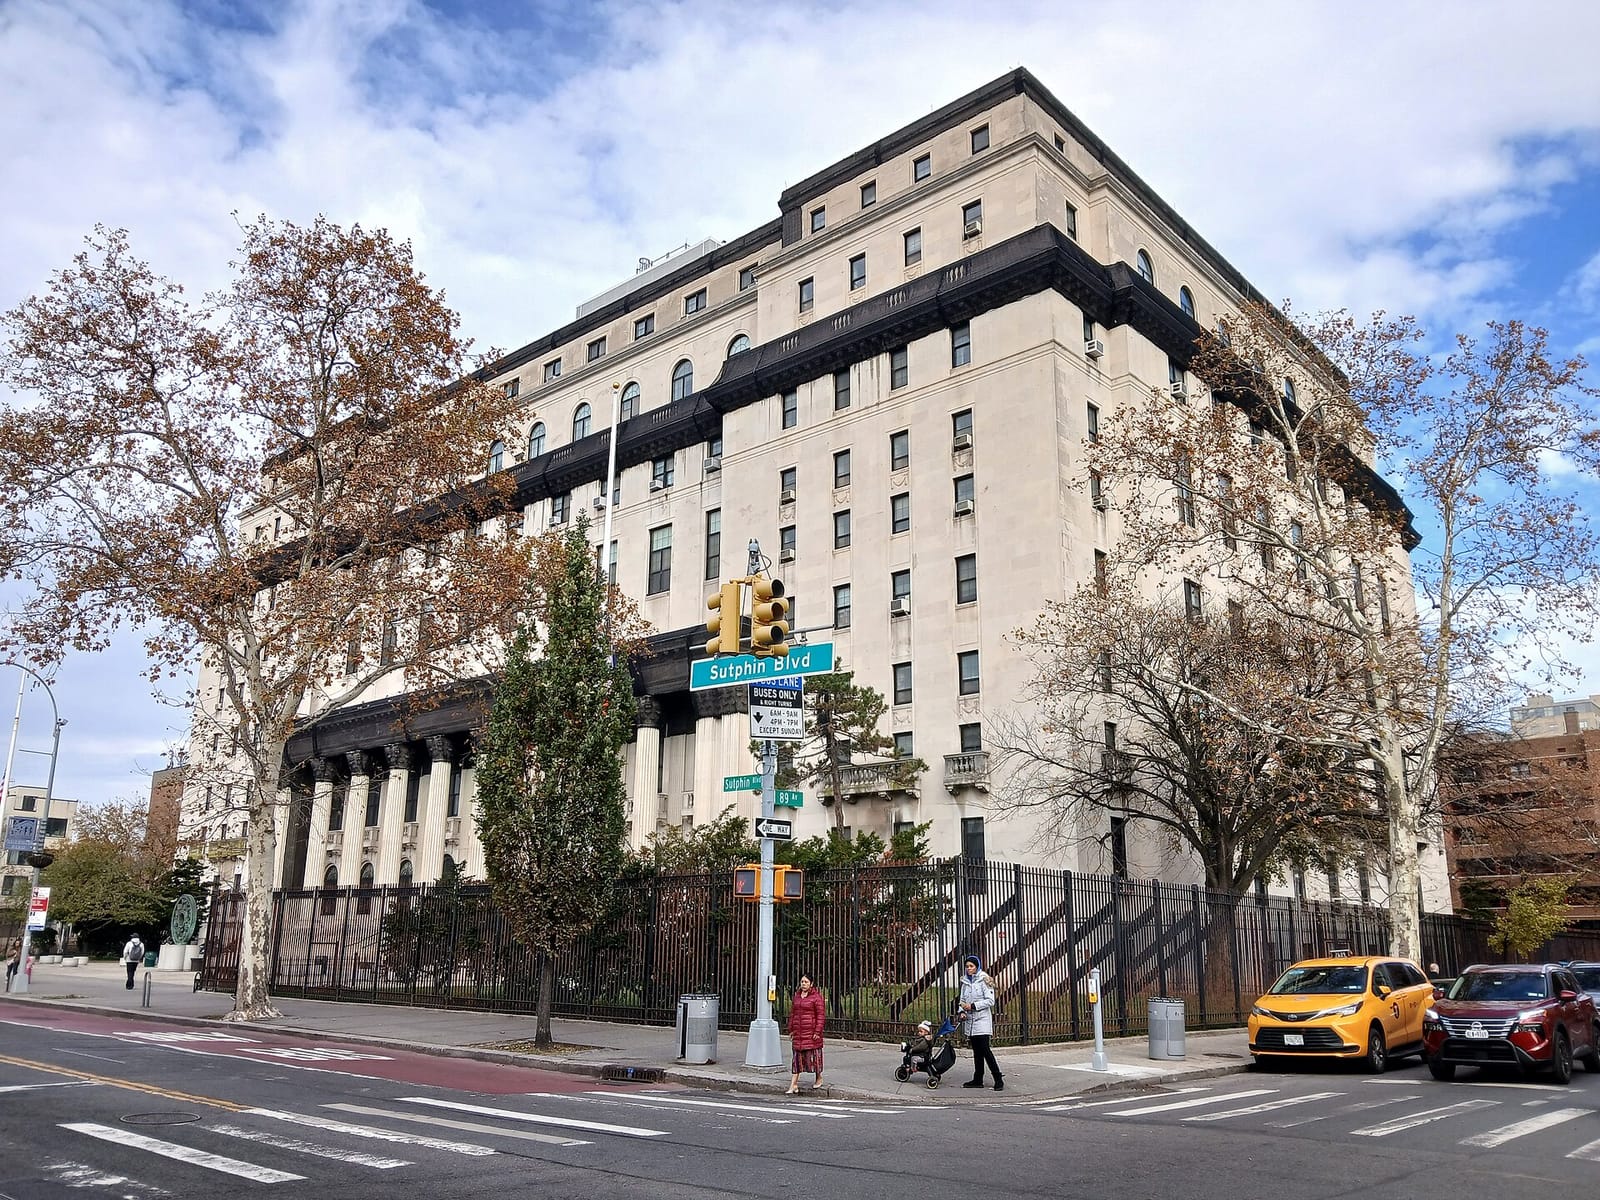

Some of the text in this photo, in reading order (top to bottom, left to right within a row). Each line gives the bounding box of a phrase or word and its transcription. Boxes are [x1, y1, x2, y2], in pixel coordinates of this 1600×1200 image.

[710, 652, 811, 680] Sutphin Blvd
[778, 677, 799, 687] LANE
[753, 687, 798, 700] BUSES ONLY
[770, 709, 782, 717] 6AM
[786, 710, 798, 718] 9AM
[770, 718, 782, 726] 4PM
[787, 719, 799, 727] 7PM
[759, 726, 802, 735] EXCEPT SUNDAY
[725, 777, 751, 790] Sutphin
[779, 792, 789, 804] 89
[762, 824, 788, 833] ONE WAY
